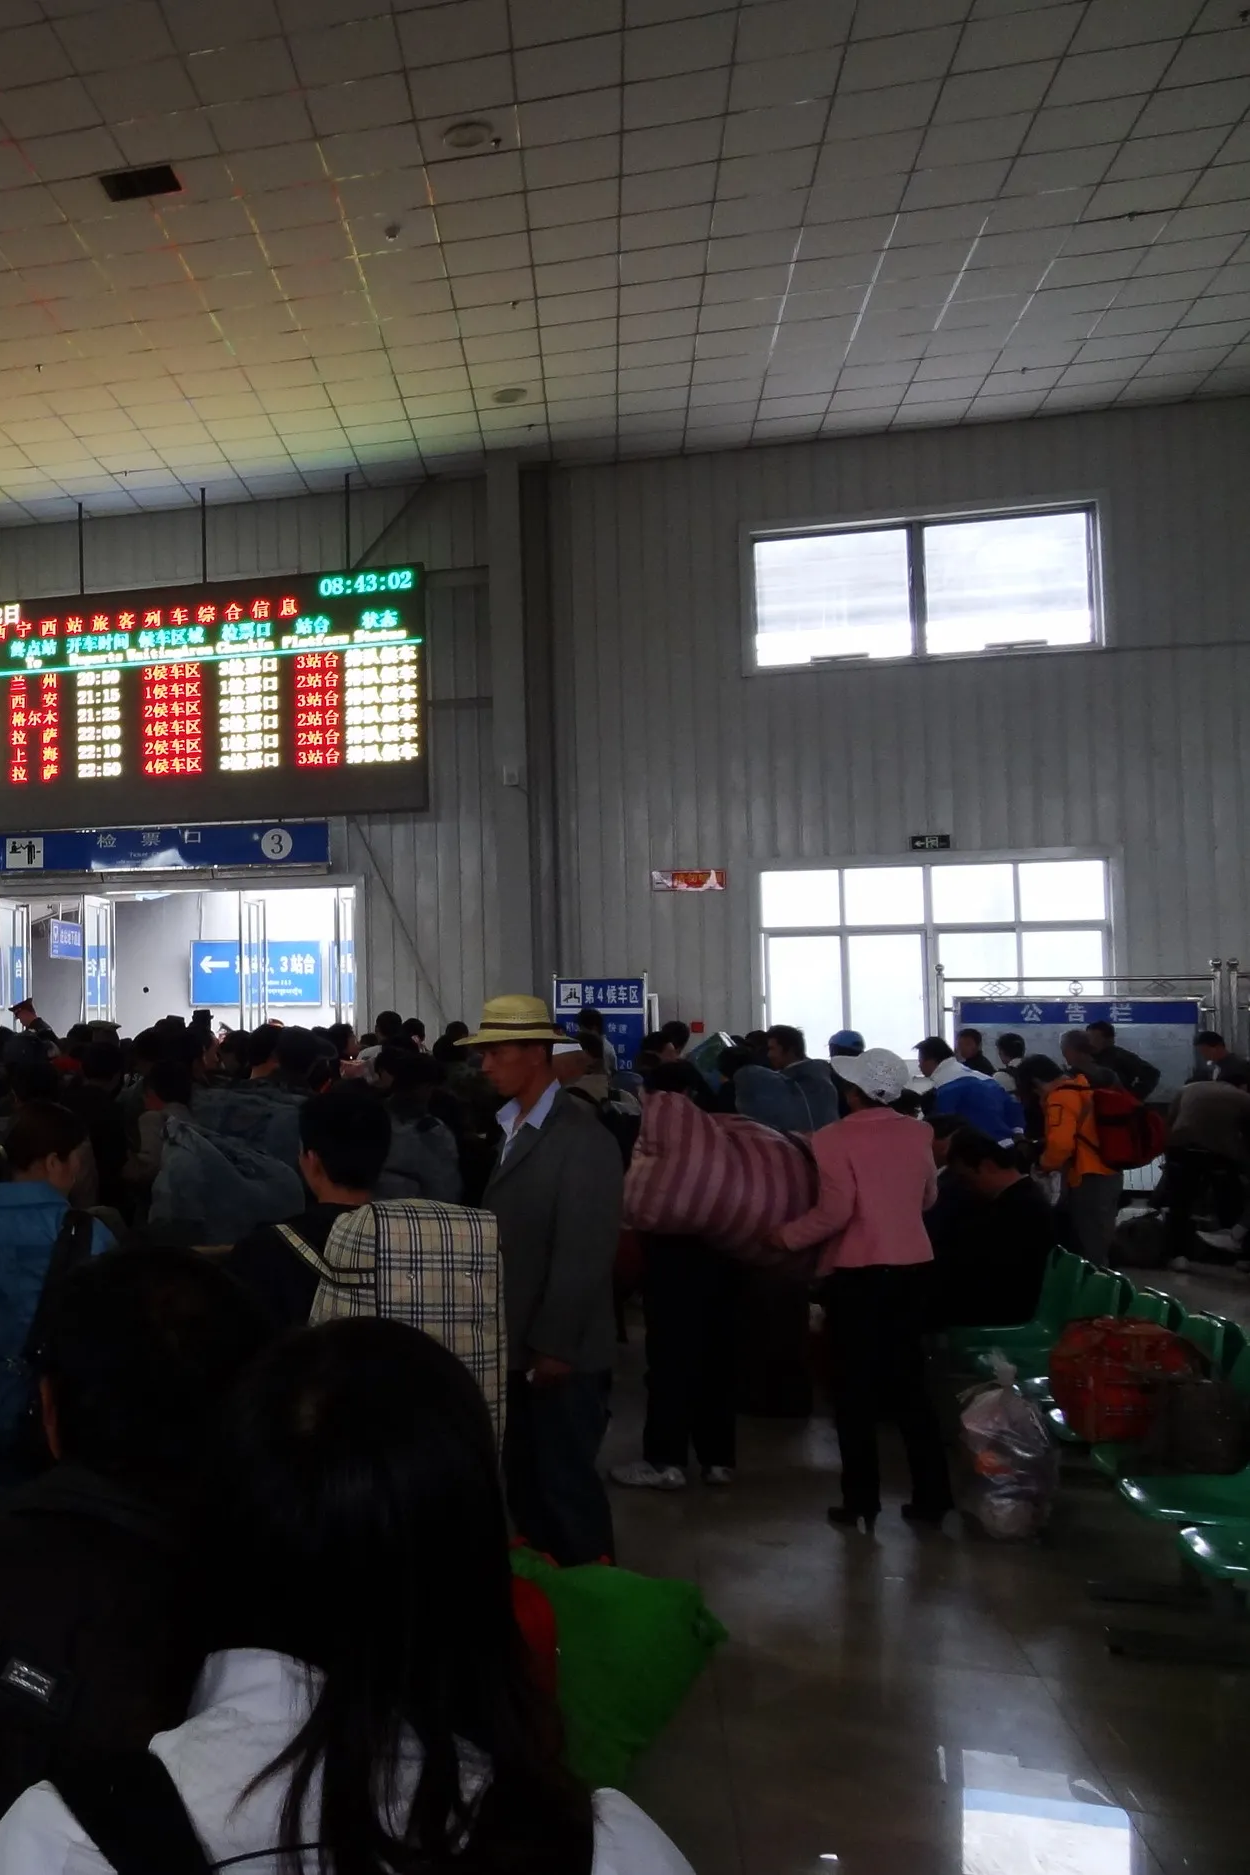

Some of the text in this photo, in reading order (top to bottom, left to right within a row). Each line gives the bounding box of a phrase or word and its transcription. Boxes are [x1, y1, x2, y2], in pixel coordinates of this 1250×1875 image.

[319, 571, 412, 596] 08:43:02
[295, 617, 330, 635] 站台
[10, 673, 58, 692] 兰州
[297, 652, 339, 669] 3站台
[11, 692, 59, 710] 西安
[297, 671, 339, 688] 2站台
[11, 709, 59, 728] 格尔木
[297, 690, 339, 707] 3站台
[11, 728, 59, 747] 拉萨
[297, 709, 339, 727] 2站台
[11, 747, 59, 765] 上海
[297, 728, 340, 746] 2站台
[11, 764, 60, 784] 拉萨
[297, 748, 340, 765] 3站台
[96, 831, 201, 849] 检票口
[584, 985, 639, 1004] 第4候车区
[1021, 1003, 1133, 1022] 公告栏
